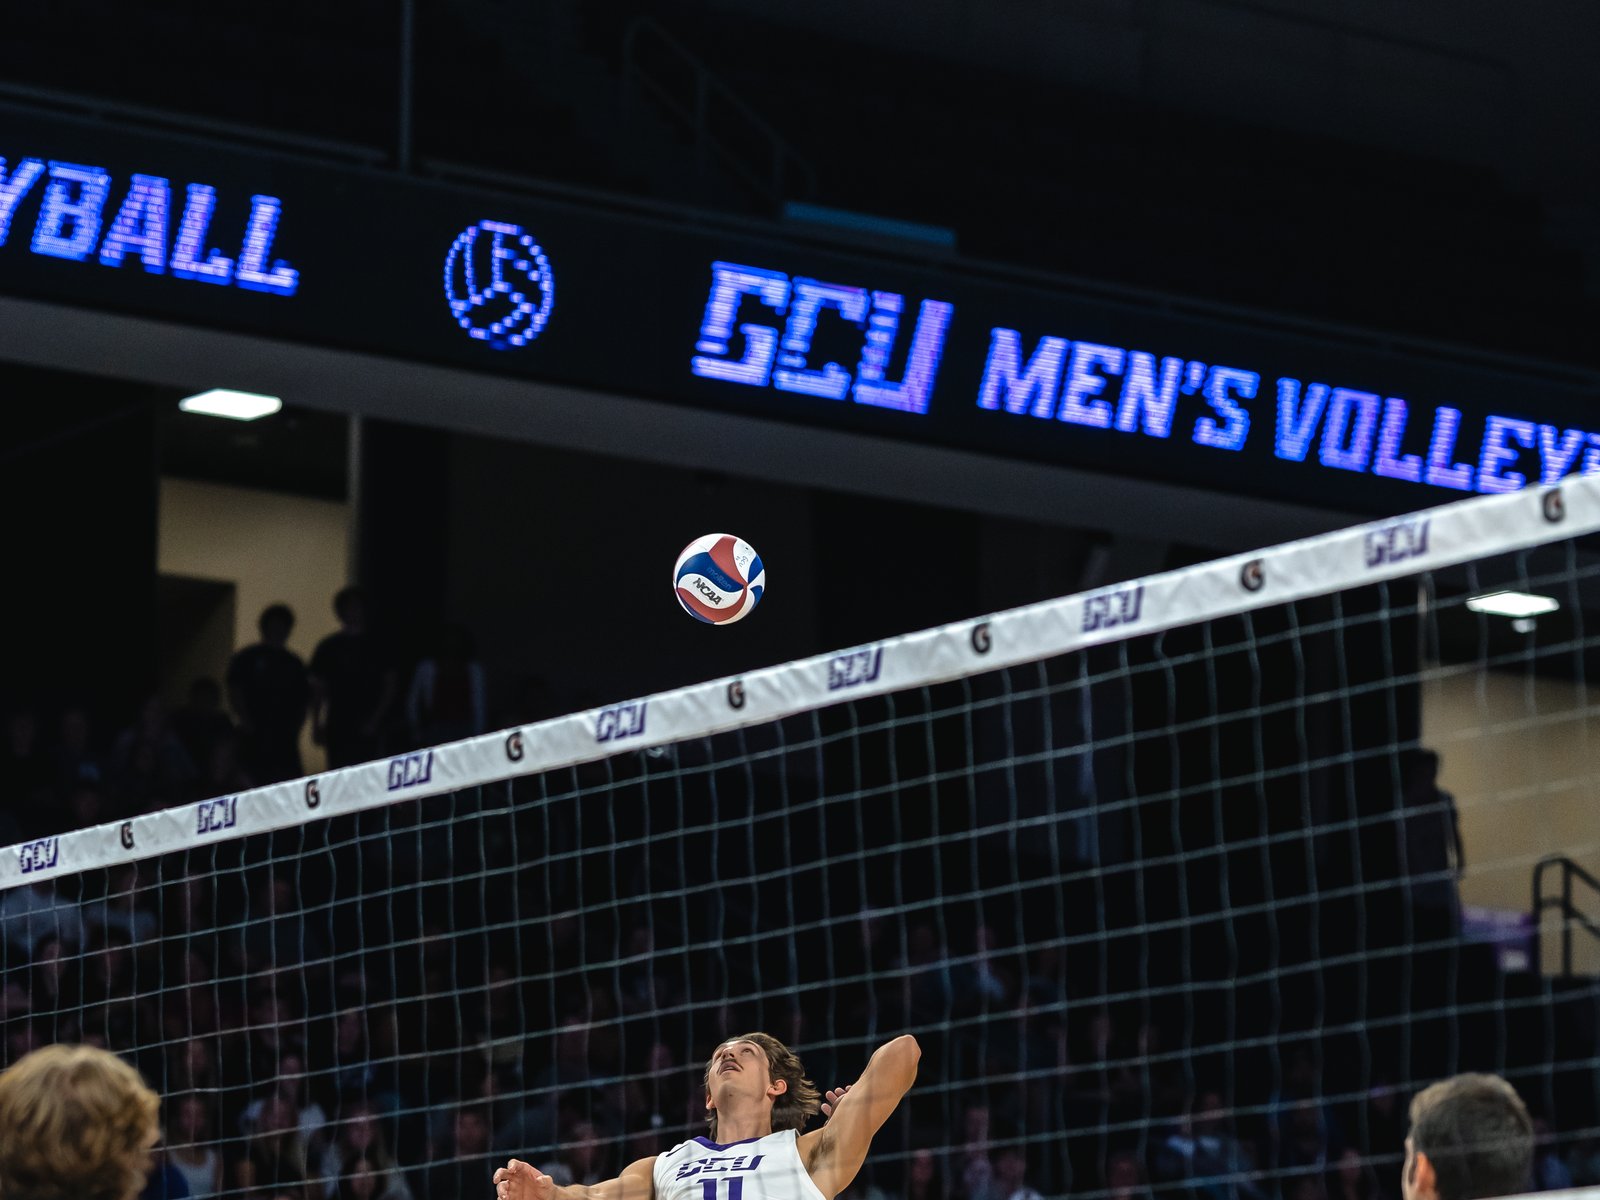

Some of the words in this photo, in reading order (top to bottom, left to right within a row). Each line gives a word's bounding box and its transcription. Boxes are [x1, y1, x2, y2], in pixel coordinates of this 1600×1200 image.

[691, 260, 954, 416] GCU
[977, 327, 1260, 452] MEN'S
[1364, 518, 1430, 568] GCU
[692, 577, 723, 605] NCAA
[1082, 586, 1145, 633] GCU
[828, 646, 883, 690] GCU
[596, 701, 648, 743] GCU
[388, 750, 433, 790] GCU
[197, 796, 237, 834] GCU
[20, 837, 59, 874] GCU
[675, 1154, 766, 1181] GCU
